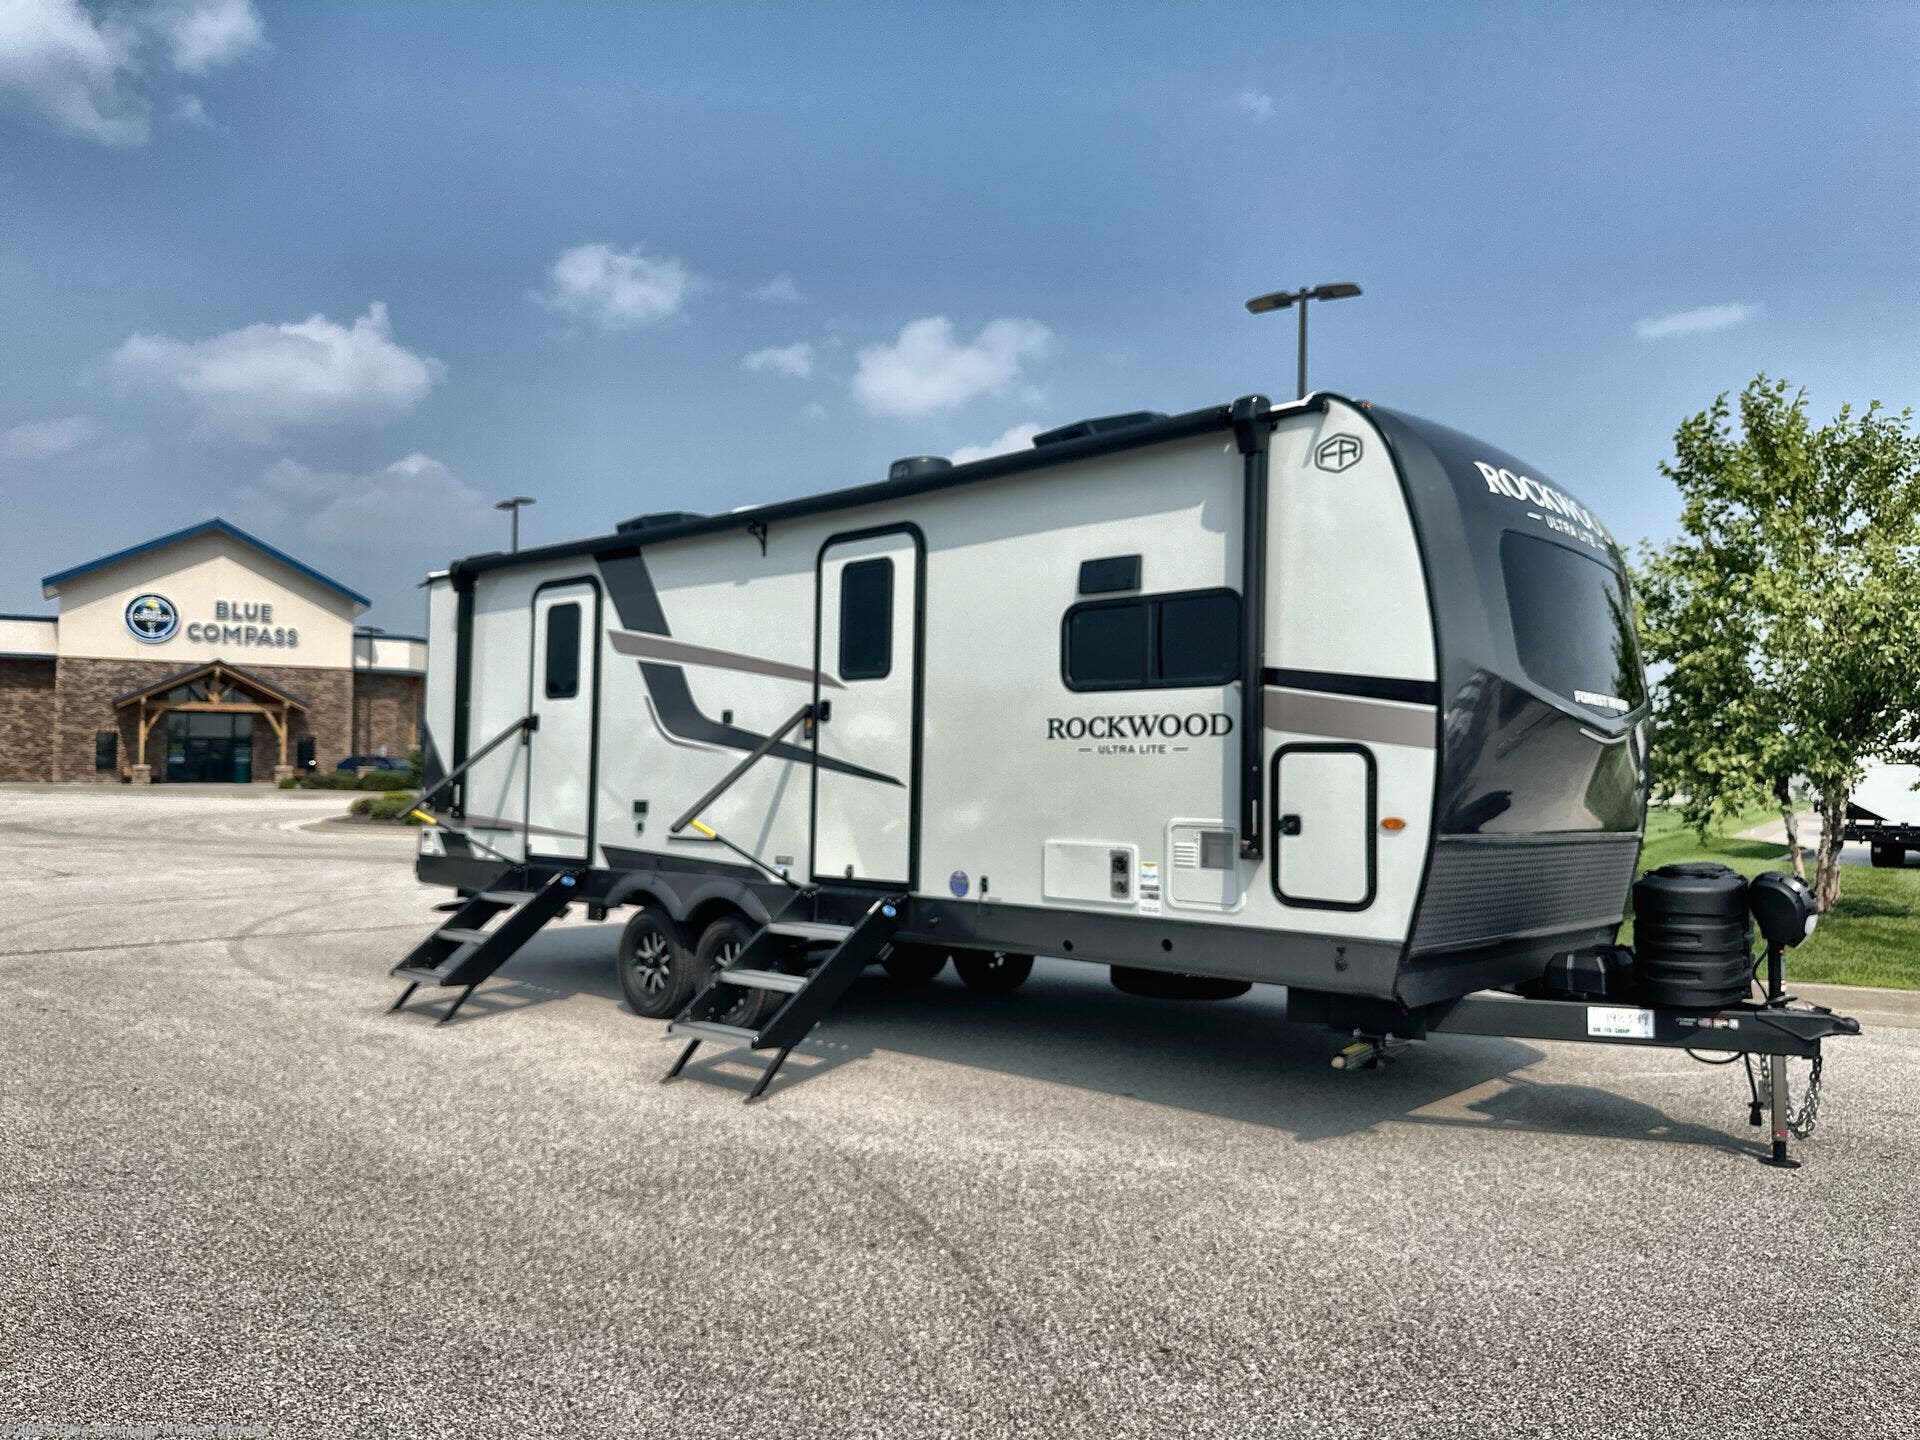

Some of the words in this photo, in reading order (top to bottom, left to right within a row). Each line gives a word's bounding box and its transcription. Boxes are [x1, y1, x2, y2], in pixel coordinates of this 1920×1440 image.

[1545, 515, 1577, 537] ULTRA
[1577, 528, 1596, 548] LITE
[215, 600, 273, 623] BLUE
[187, 622, 299, 647] COMPASS
[1046, 713, 1234, 740] ROCKWOOD
[1098, 745, 1136, 755] ULTRA
[1139, 744, 1167, 754] LITE
